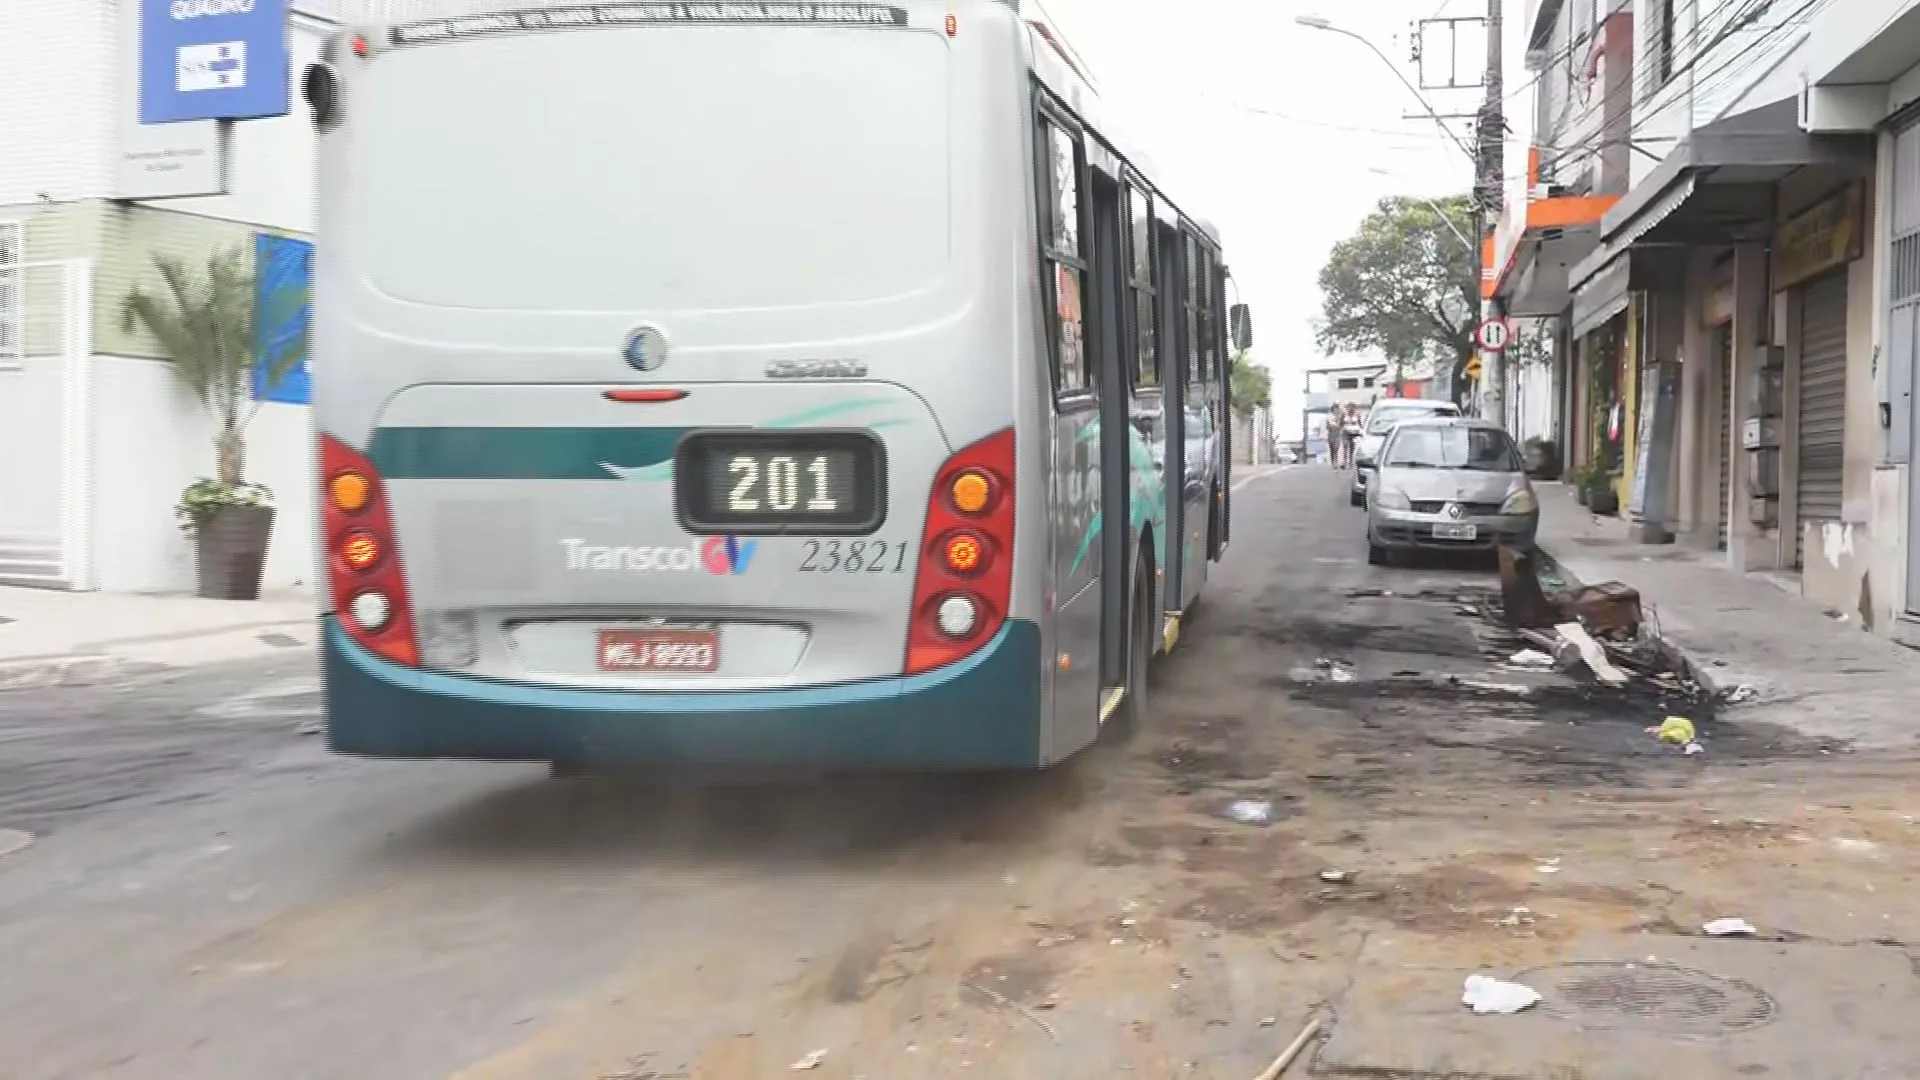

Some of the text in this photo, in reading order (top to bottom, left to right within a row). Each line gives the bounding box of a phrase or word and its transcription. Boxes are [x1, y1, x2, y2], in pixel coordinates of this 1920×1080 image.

[170, 0, 256, 20] QUADRO
[728, 456, 838, 511] 201
[798, 539, 908, 572] 23821
